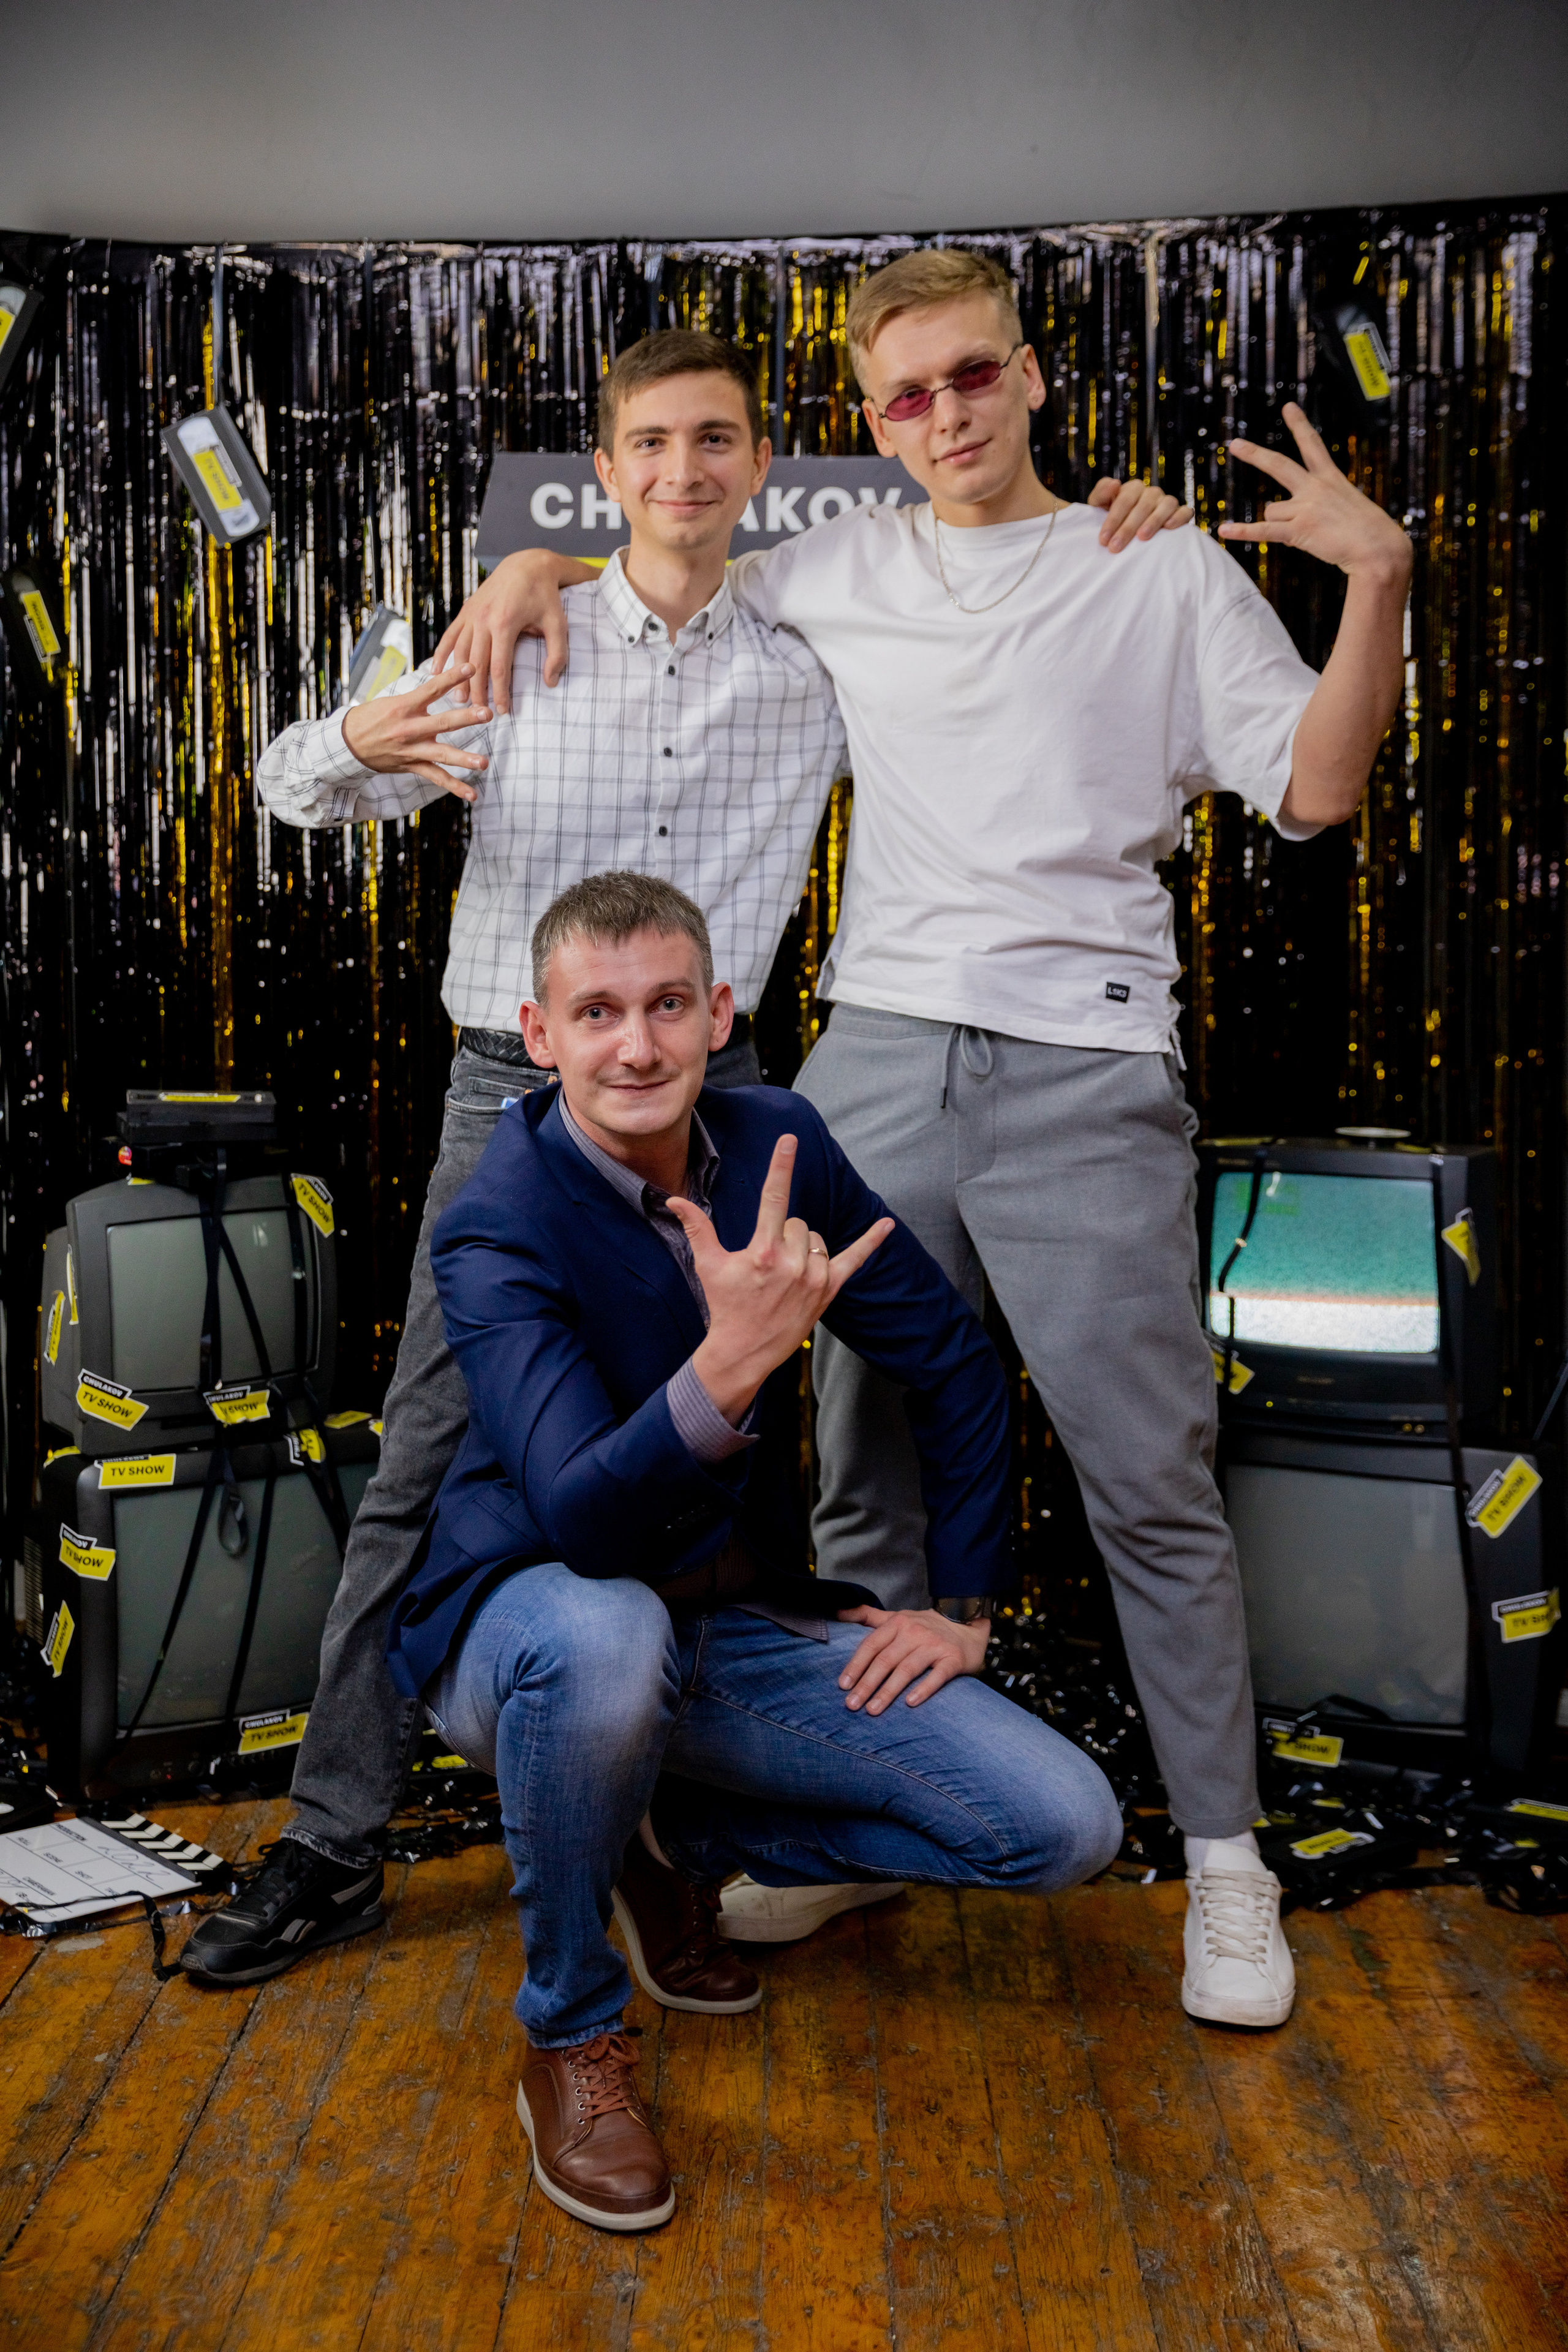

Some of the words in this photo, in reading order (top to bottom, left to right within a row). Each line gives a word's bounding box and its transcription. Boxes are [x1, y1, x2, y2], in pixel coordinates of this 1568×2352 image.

[530, 482, 903, 532] CHAKO
[309, 1196, 331, 1223] SHOW
[83, 1375, 123, 1397] CHULAKOV
[83, 1391, 98, 1403] TV
[97, 1398, 134, 1418] SHOW
[111, 1467, 126, 1477] TV
[128, 1464, 165, 1476] SHOW
